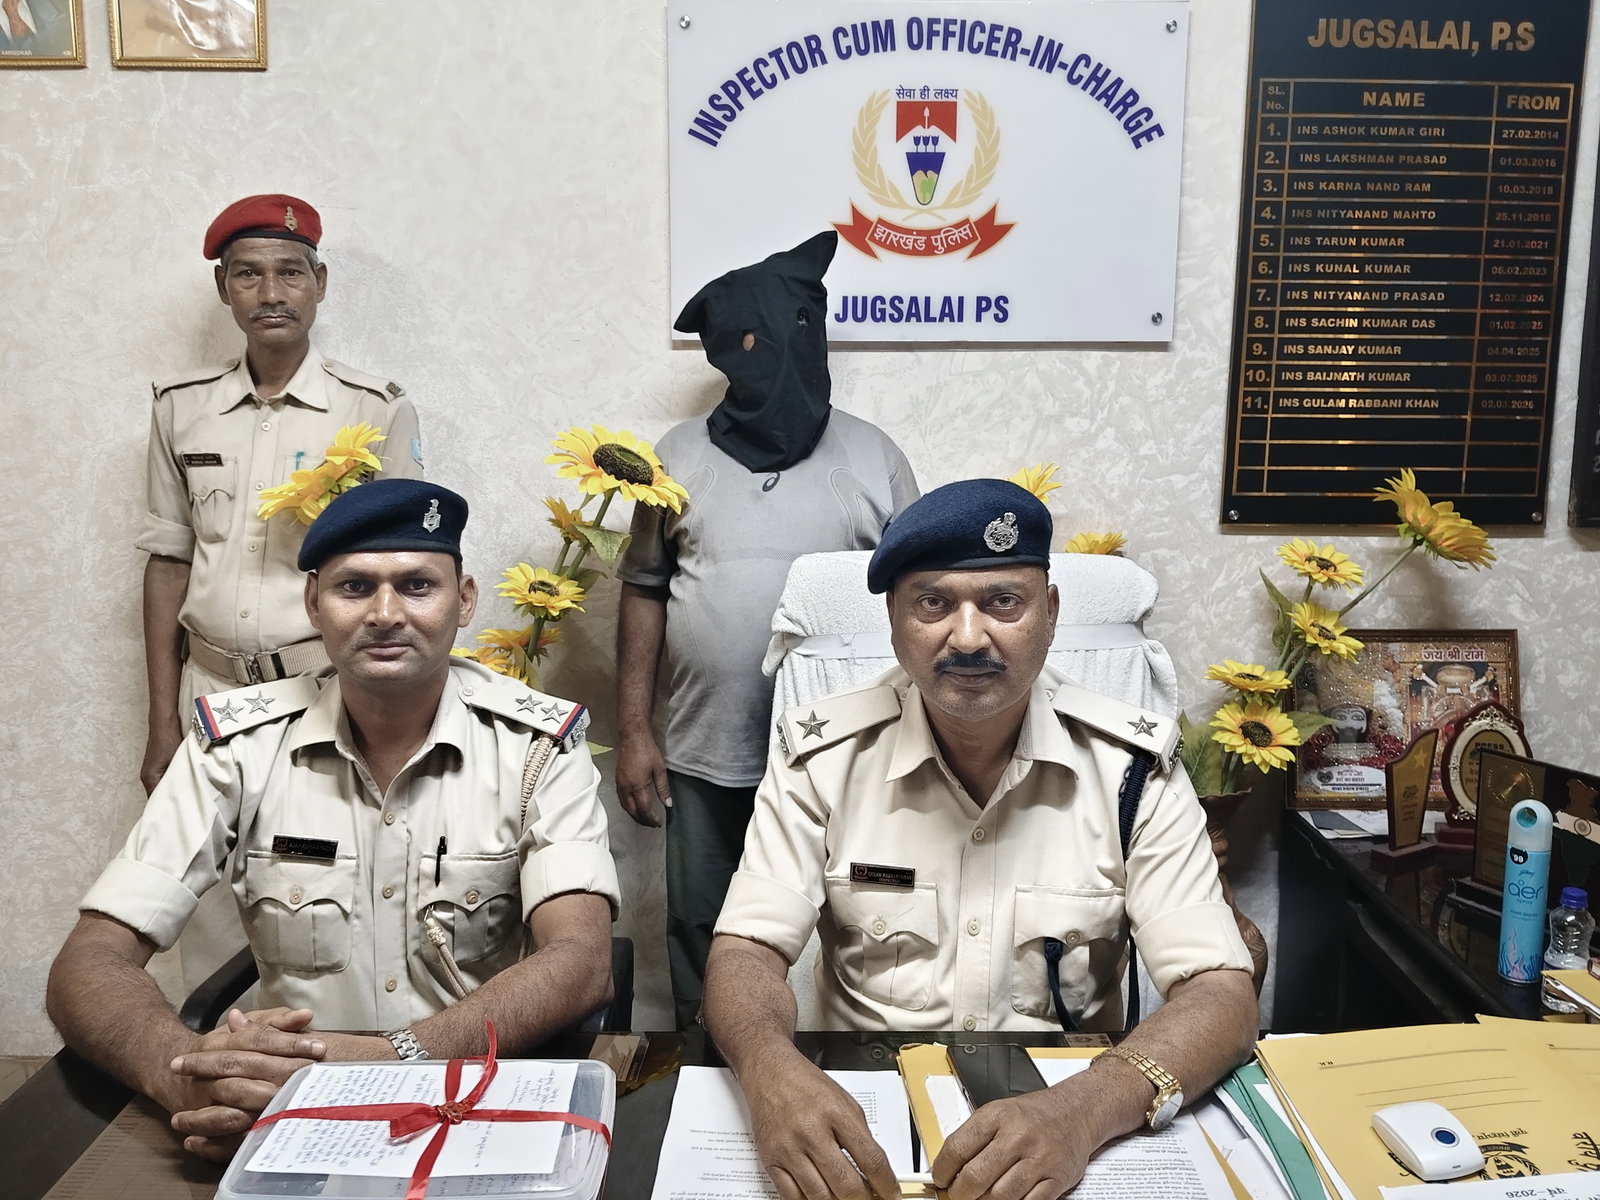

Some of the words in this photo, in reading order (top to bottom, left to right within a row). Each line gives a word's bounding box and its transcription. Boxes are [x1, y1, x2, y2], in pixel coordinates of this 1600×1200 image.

[1308, 18, 1480, 56] JUGSALAI,
[1491, 21, 1536, 52] P.S
[687, 33, 829, 149] INSPECTOR
[833, 19, 897, 60] CUM
[906, 16, 1165, 151] OFFICER-IN-CHARGE
[896, 85, 916, 100] सेवा
[919, 85, 930, 100] ही
[934, 88, 959, 100] लक्ष्य
[1267, 85, 1285, 96] SL.
[1266, 100, 1285, 111] No.
[1363, 91, 1426, 108] NAME
[1506, 94, 1561, 111] FROM
[1267, 123, 1282, 137] 1.
[1297, 125, 1318, 136] INS
[1323, 126, 1365, 136] ASHOK
[1370, 126, 1416, 137] KUMAR
[1419, 127, 1446, 137] GIRI
[1502, 129, 1559, 139] 27.02.2014
[1264, 151, 1280, 165] 2.
[1300, 153, 1321, 163] INS
[1325, 153, 1395, 164] LAKSHMAN
[1399, 154, 1448, 165] PRASAD
[1500, 157, 1557, 168] 01.03.2016
[1262, 179, 1278, 192] 3.
[1293, 181, 1315, 191] INS
[1318, 181, 1362, 192] KARNA
[1366, 181, 1400, 192] NAND
[1405, 182, 1431, 192] RAM
[1261, 206, 1276, 220] 4.
[1292, 208, 1313, 219] INS
[1317, 209, 1388, 220] NITYANAND
[1393, 210, 1436, 220] MAHTO
[873, 223, 927, 251] झारखंड
[931, 223, 973, 254] पुलिस
[1259, 234, 1274, 247] 5.
[1290, 236, 1311, 247] INS
[1315, 236, 1357, 247] TARUN
[1361, 237, 1405, 247] KUMAR
[1493, 239, 1549, 249] 21.01.2021
[1257, 262, 1273, 275] 6.
[1288, 263, 1311, 273] INS
[1315, 263, 1360, 273] KUNAL
[1364, 264, 1411, 274] KUMAR
[1256, 289, 1271, 302] 7.
[1286, 291, 1309, 300] INS
[1313, 291, 1389, 301] NITYANAND
[1394, 291, 1445, 301] PRASAD
[834, 295, 965, 324] JUGSALAI
[975, 296, 1010, 324] PS
[1254, 316, 1269, 329] 8.
[1285, 318, 1307, 328] INS
[1310, 318, 1358, 328] SACHIN
[1362, 318, 1408, 329] KUMAR
[1411, 319, 1436, 329] DAS
[1252, 343, 1268, 356] 9.
[1283, 344, 1305, 355] INS
[1307, 344, 1355, 355] SANJAY
[1358, 345, 1402, 356] KUMAR
[1246, 369, 1270, 383] 10.
[1281, 371, 1303, 381] INS
[1306, 371, 1365, 382] BAIJNATH
[1368, 372, 1411, 382] KUMAR
[1244, 396, 1268, 410] 11.
[1279, 398, 1300, 408] INS
[1303, 398, 1346, 408] GULAM
[1348, 398, 1402, 409] RABBANI
[1405, 399, 1439, 409] KHAN
[1422, 650, 1443, 660] जय
[1447, 646, 1461, 660] श्री
[1464, 650, 1484, 660] राम
